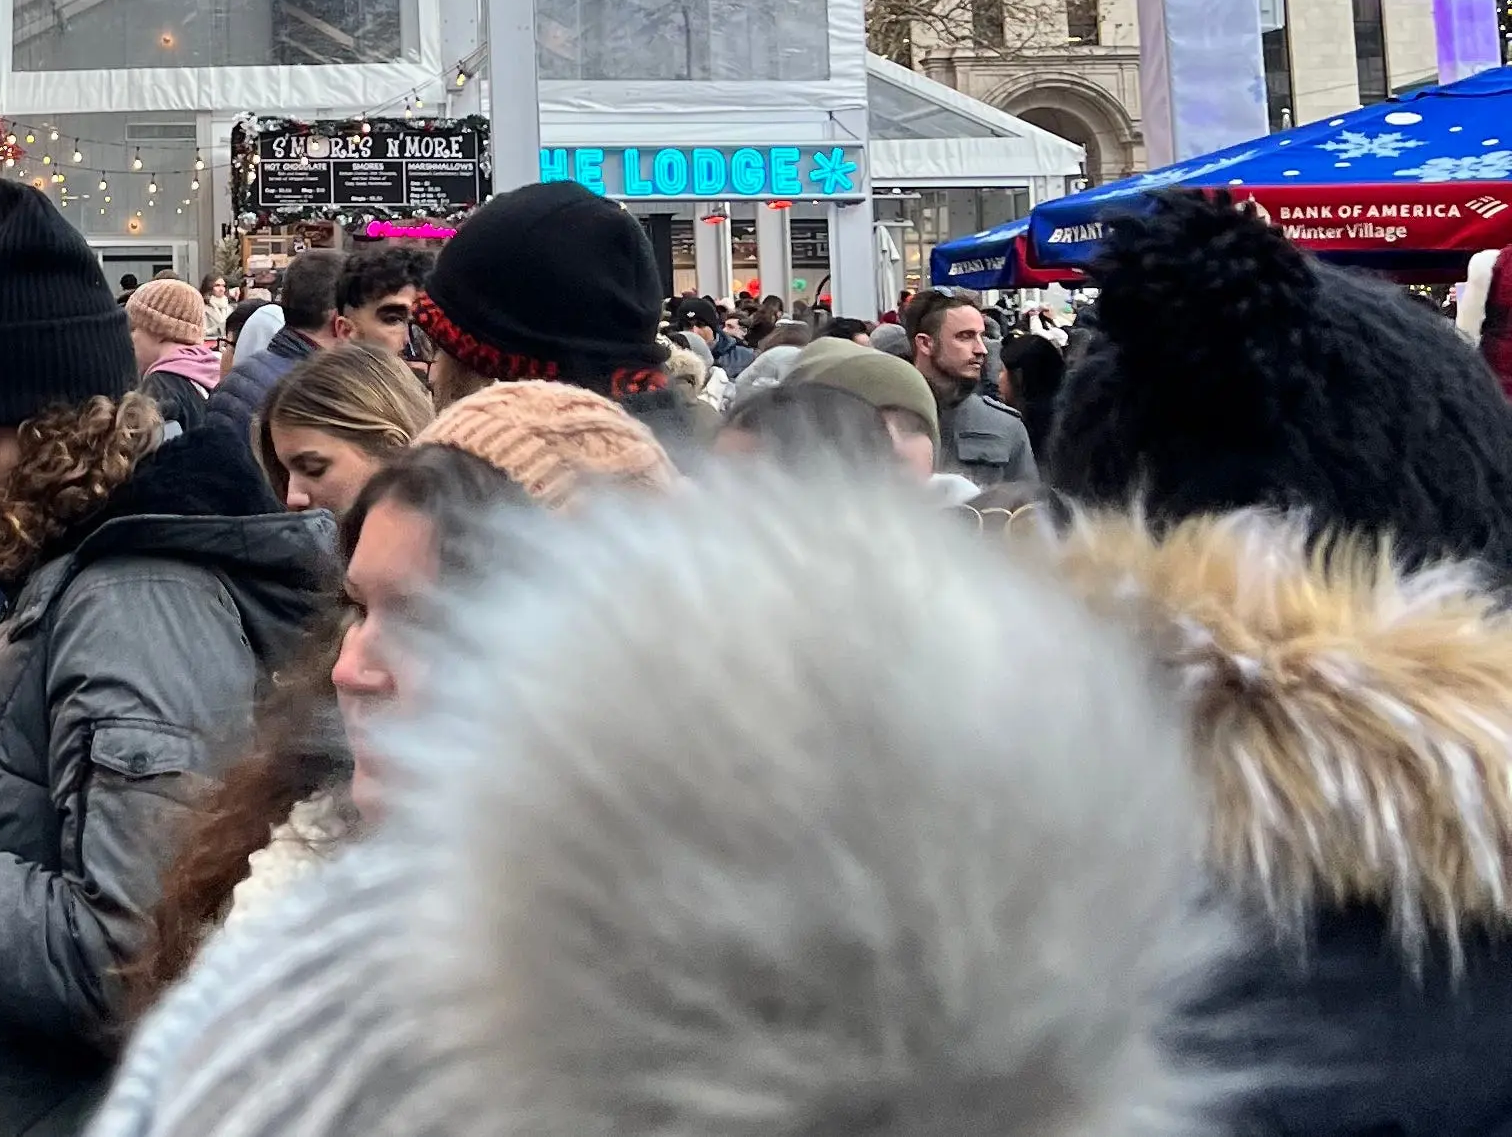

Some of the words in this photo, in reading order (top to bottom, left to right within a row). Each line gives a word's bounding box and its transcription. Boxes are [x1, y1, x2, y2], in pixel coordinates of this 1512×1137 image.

[539, 148, 605, 196] HE
[623, 147, 802, 196] LODGE
[1280, 206, 1333, 220] BANK
[1338, 205, 1363, 219] OF
[1366, 204, 1461, 218] AMERICA
[1047, 223, 1104, 244] BRYANT
[1282, 224, 1347, 240] Winter
[1345, 223, 1408, 243] Village
